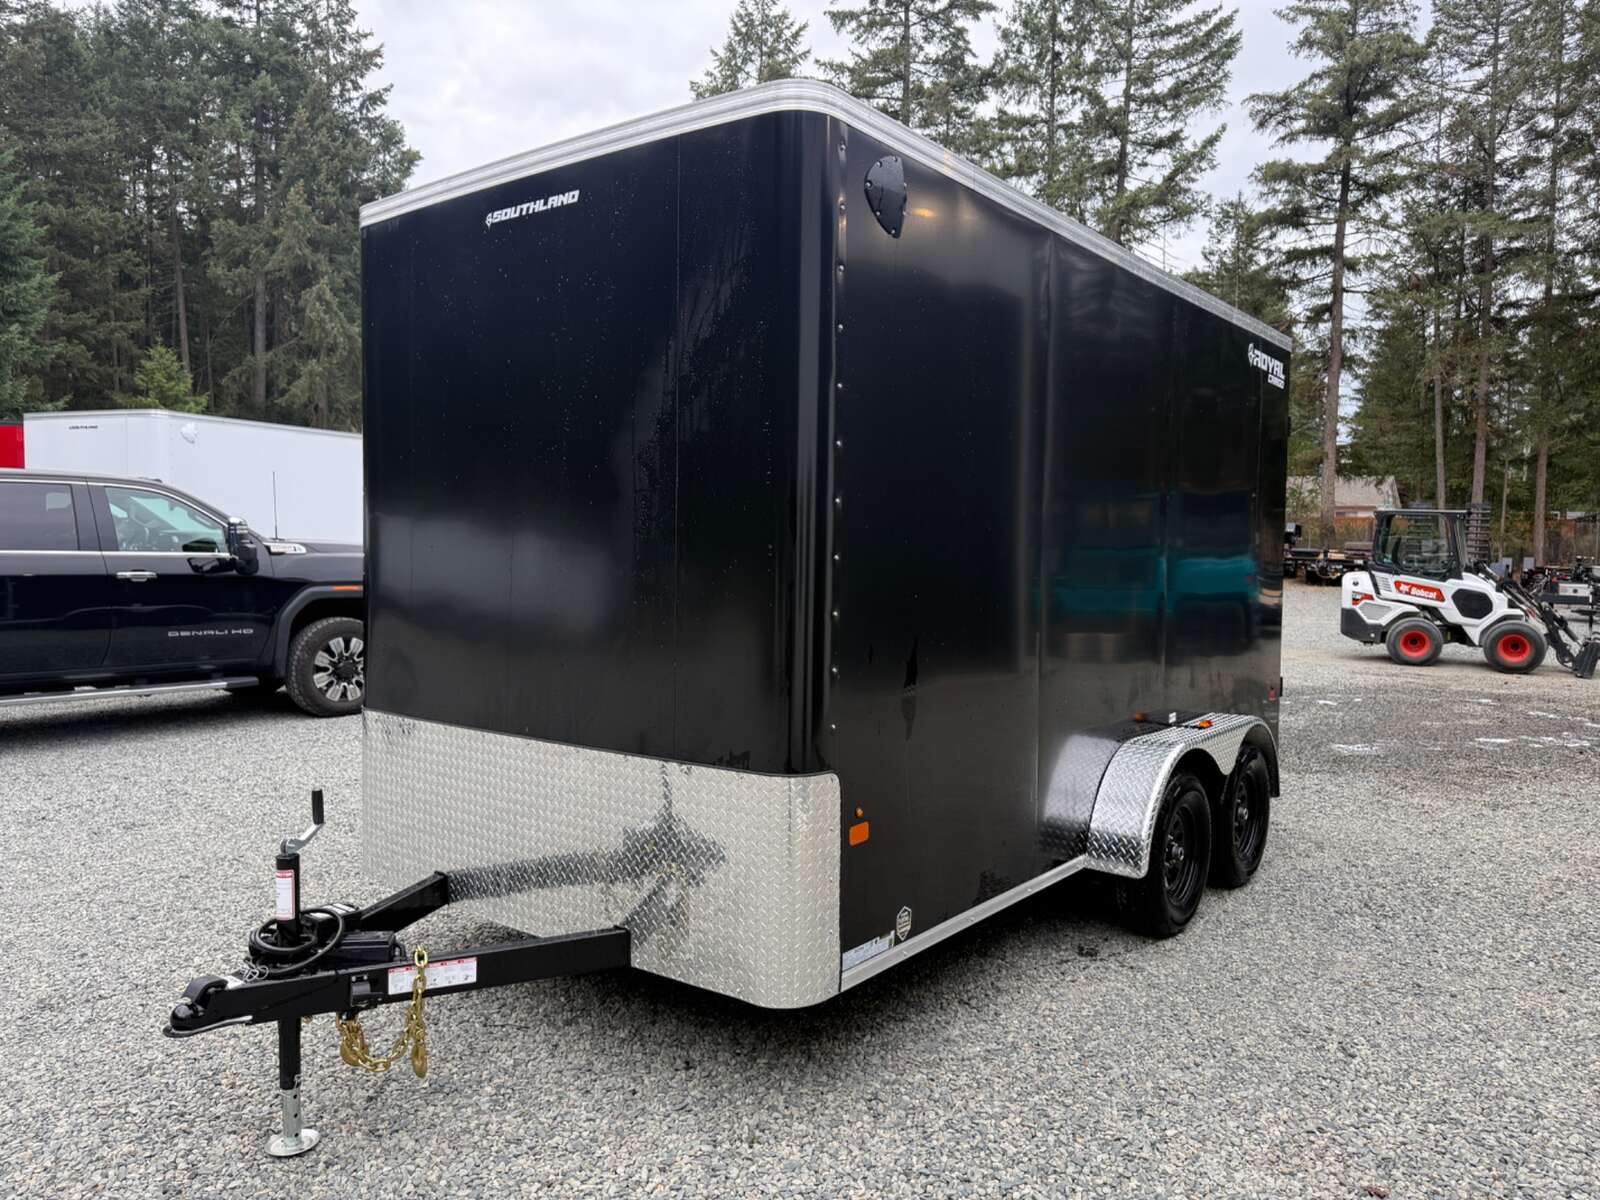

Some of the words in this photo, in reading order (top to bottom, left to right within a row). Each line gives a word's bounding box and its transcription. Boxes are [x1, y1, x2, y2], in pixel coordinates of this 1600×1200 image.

[492, 189, 580, 223] SOUTHLAND
[1253, 349, 1285, 380] ROYAL
[1410, 586, 1437, 599] Bobcat
